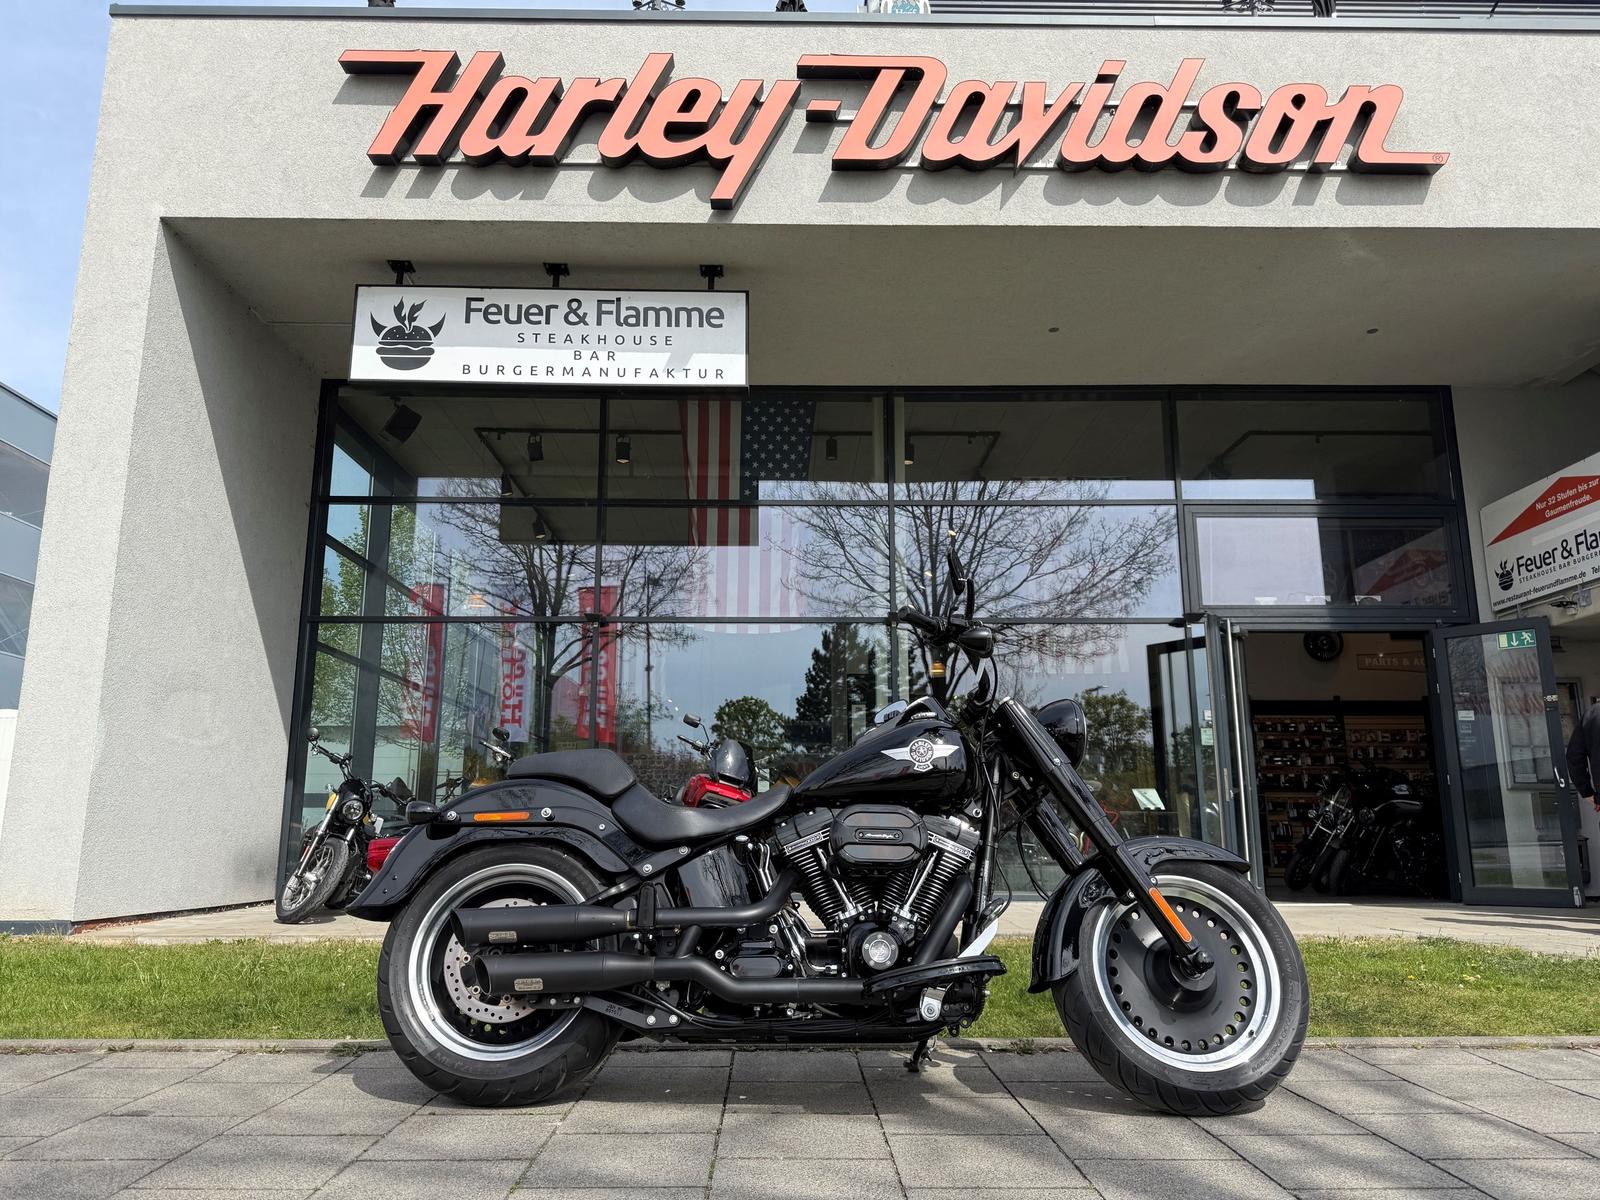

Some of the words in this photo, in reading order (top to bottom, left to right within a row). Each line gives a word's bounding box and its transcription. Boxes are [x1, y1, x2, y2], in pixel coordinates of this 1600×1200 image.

[464, 297, 559, 326] Feuer
[563, 298, 589, 327] &
[596, 297, 725, 329] Flamme
[517, 332, 673, 347] STEAKHOUSE
[462, 364, 724, 380] BURGERMANUFAKTUR
[573, 350, 616, 362] BAR
[1535, 501, 1548, 511] Nur
[1556, 488, 1577, 502] Stufen
[1577, 482, 1588, 492] bis
[1588, 478, 1600, 488] zur
[1516, 547, 1558, 576] Feuer
[1560, 538, 1574, 560] &
[1574, 529, 1600, 555] Fla
[1518, 566, 1557, 584] STEAKHOUSE
[1558, 561, 1571, 570] BAR
[1573, 549, 1600, 565] BURGER
